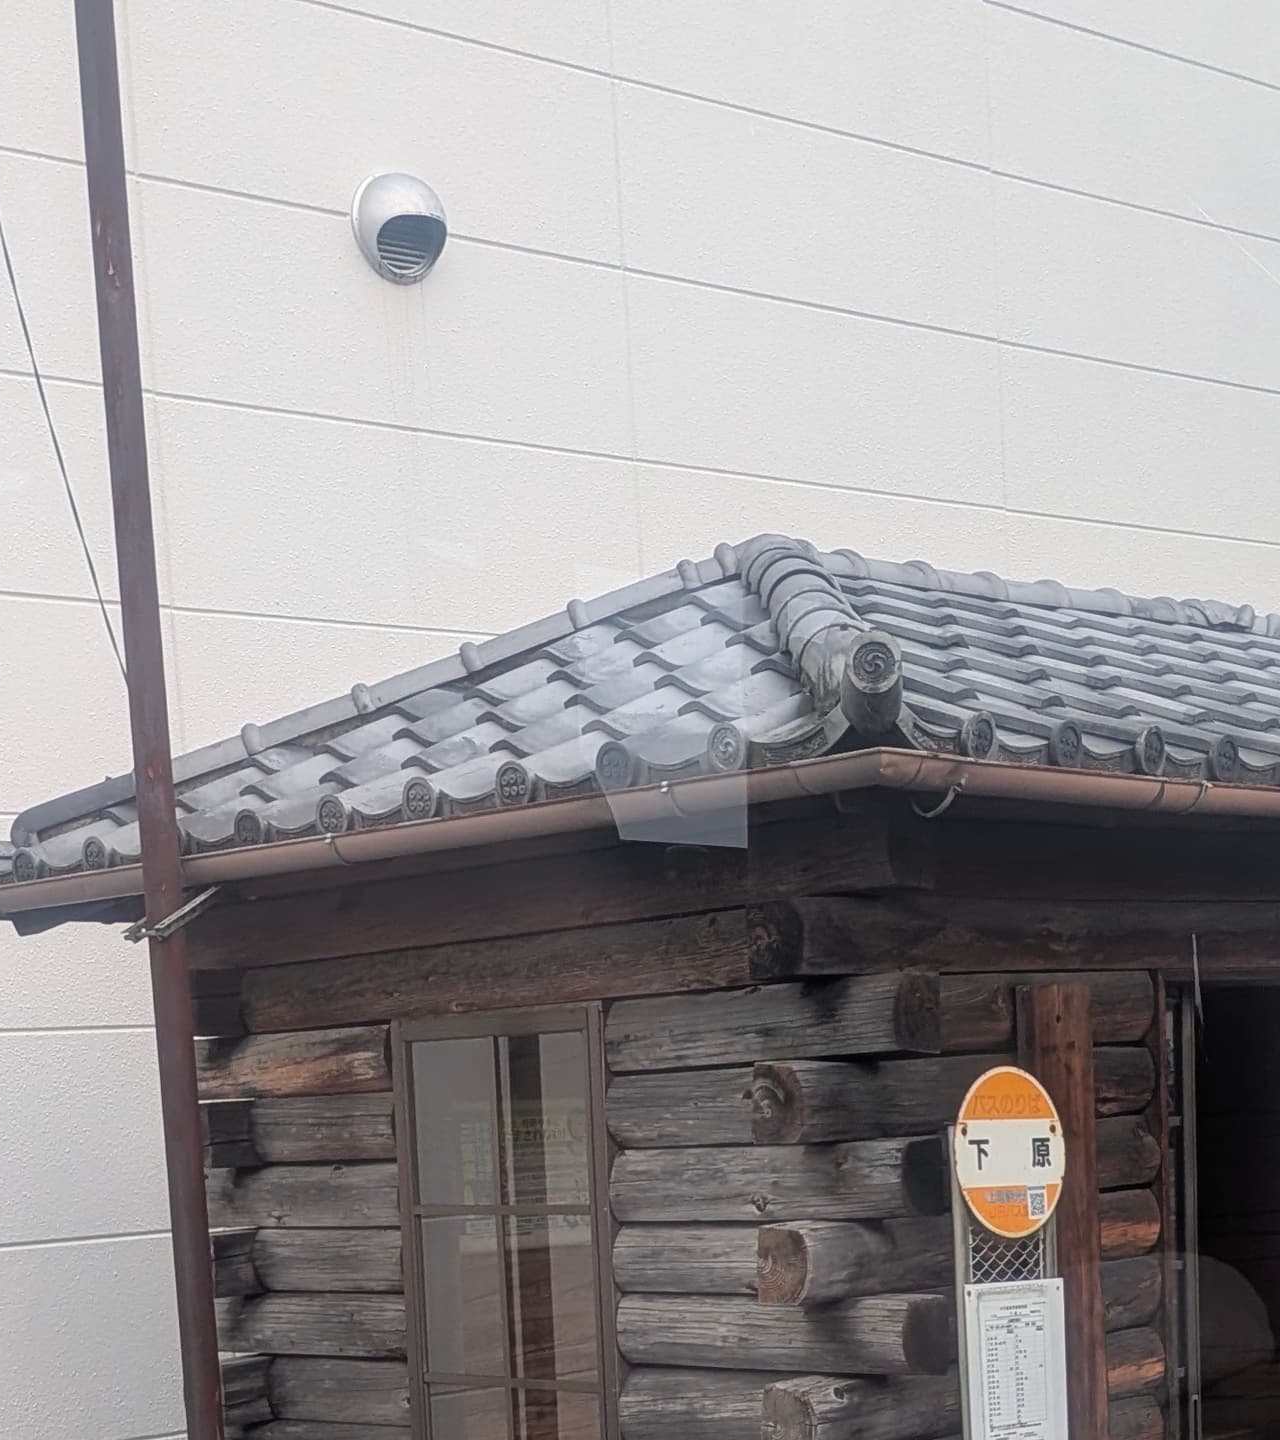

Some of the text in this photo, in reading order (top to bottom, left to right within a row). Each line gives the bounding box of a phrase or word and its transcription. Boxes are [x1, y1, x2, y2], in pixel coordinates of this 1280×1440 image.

[972, 1093, 1041, 1115] バスのりば
[968, 1137, 1052, 1171] 下原
